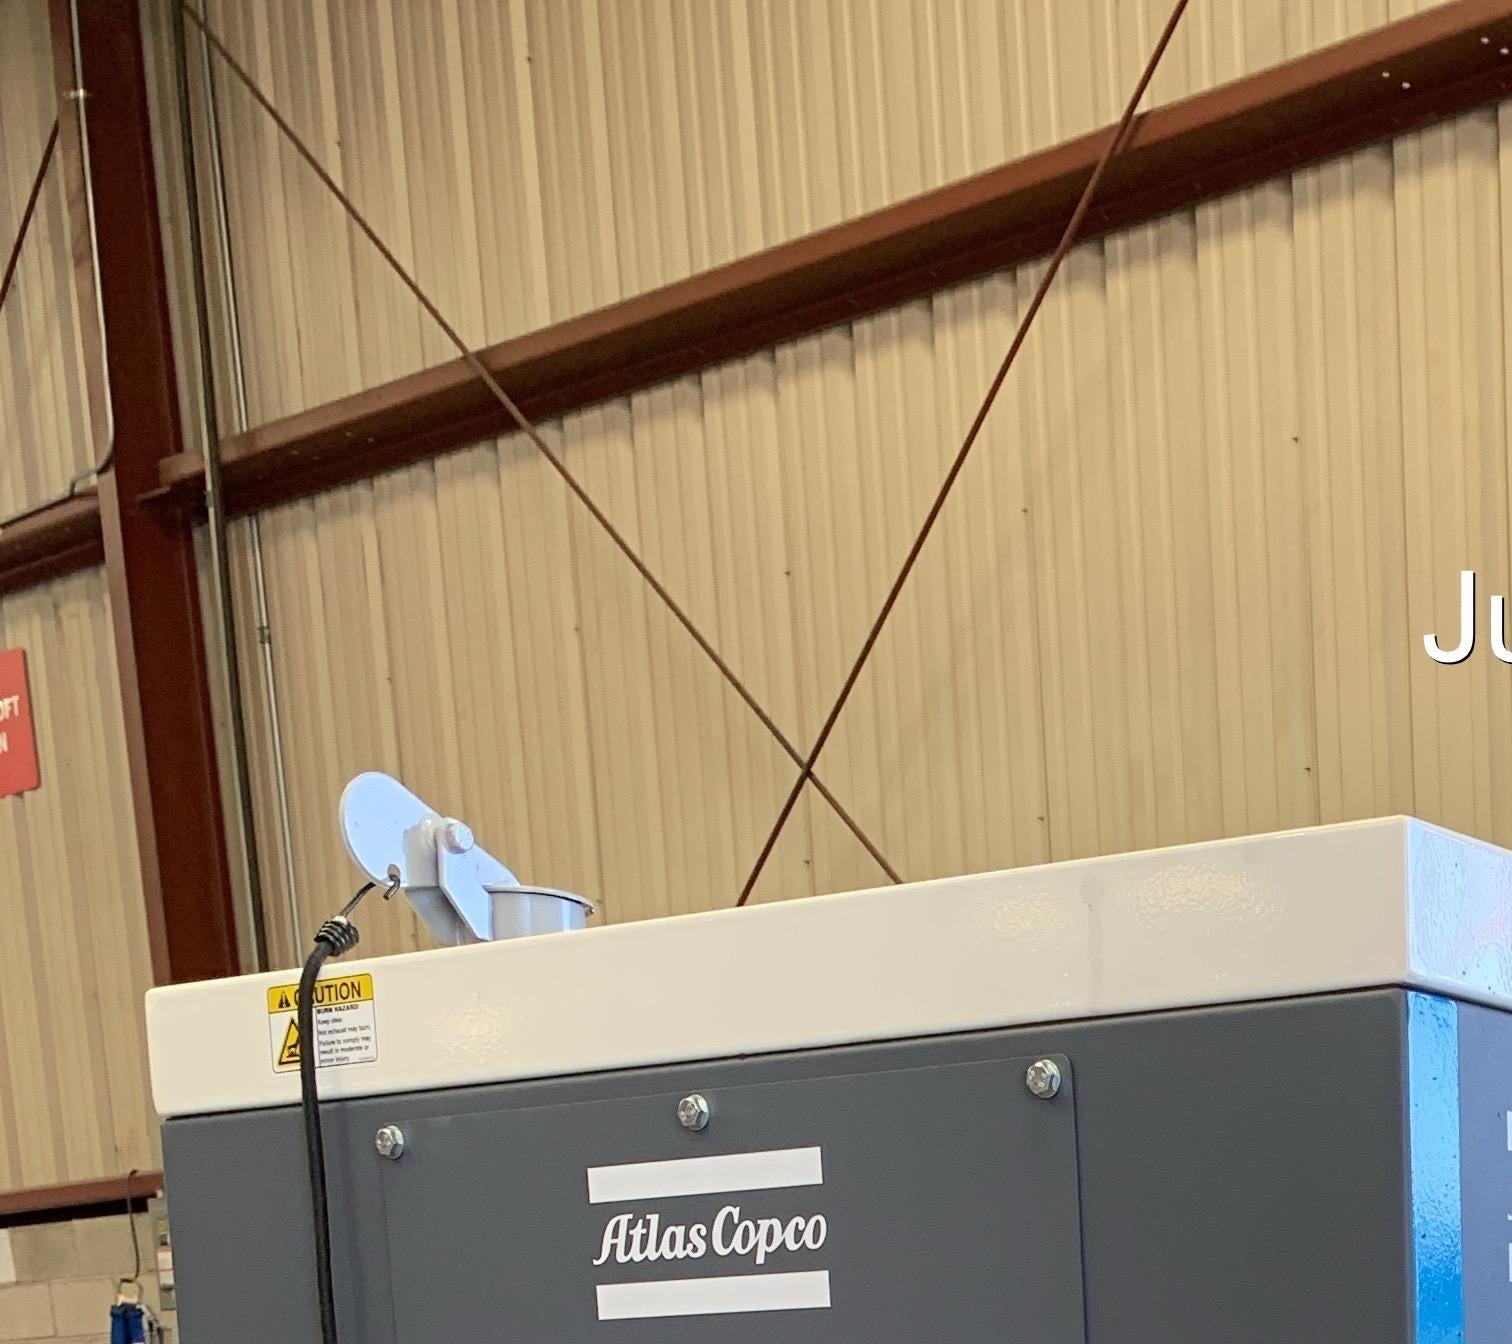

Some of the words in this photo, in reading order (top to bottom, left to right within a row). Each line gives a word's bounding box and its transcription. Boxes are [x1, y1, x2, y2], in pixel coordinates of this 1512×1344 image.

[294, 981, 362, 1005] CUTION
[592, 1212, 708, 1266] Atlas
[711, 1205, 828, 1265] Copco
